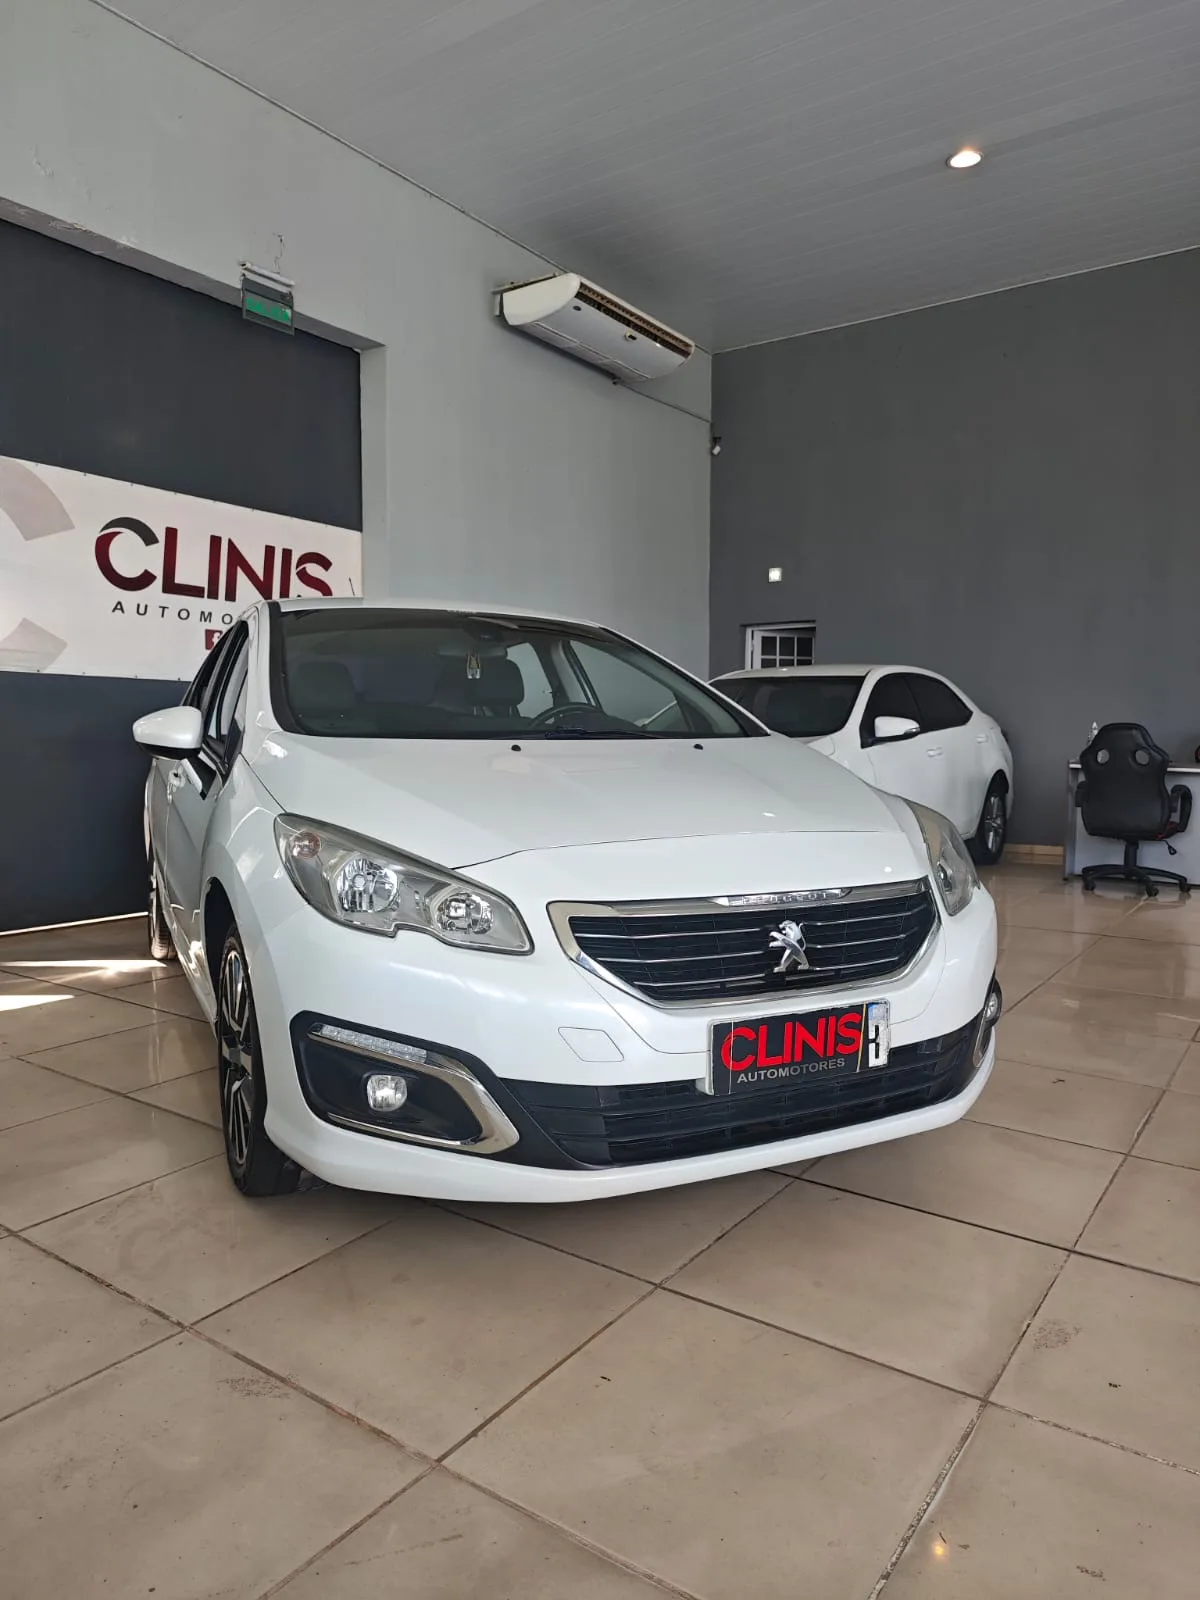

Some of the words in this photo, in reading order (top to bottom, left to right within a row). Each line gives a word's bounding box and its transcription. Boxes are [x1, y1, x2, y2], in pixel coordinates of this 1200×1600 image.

[95, 516, 333, 602] CLINIS
[111, 600, 234, 625] AUTOMO
[721, 1012, 863, 1071] CLINIS
[737, 1057, 845, 1083] AUTOMOTORES
